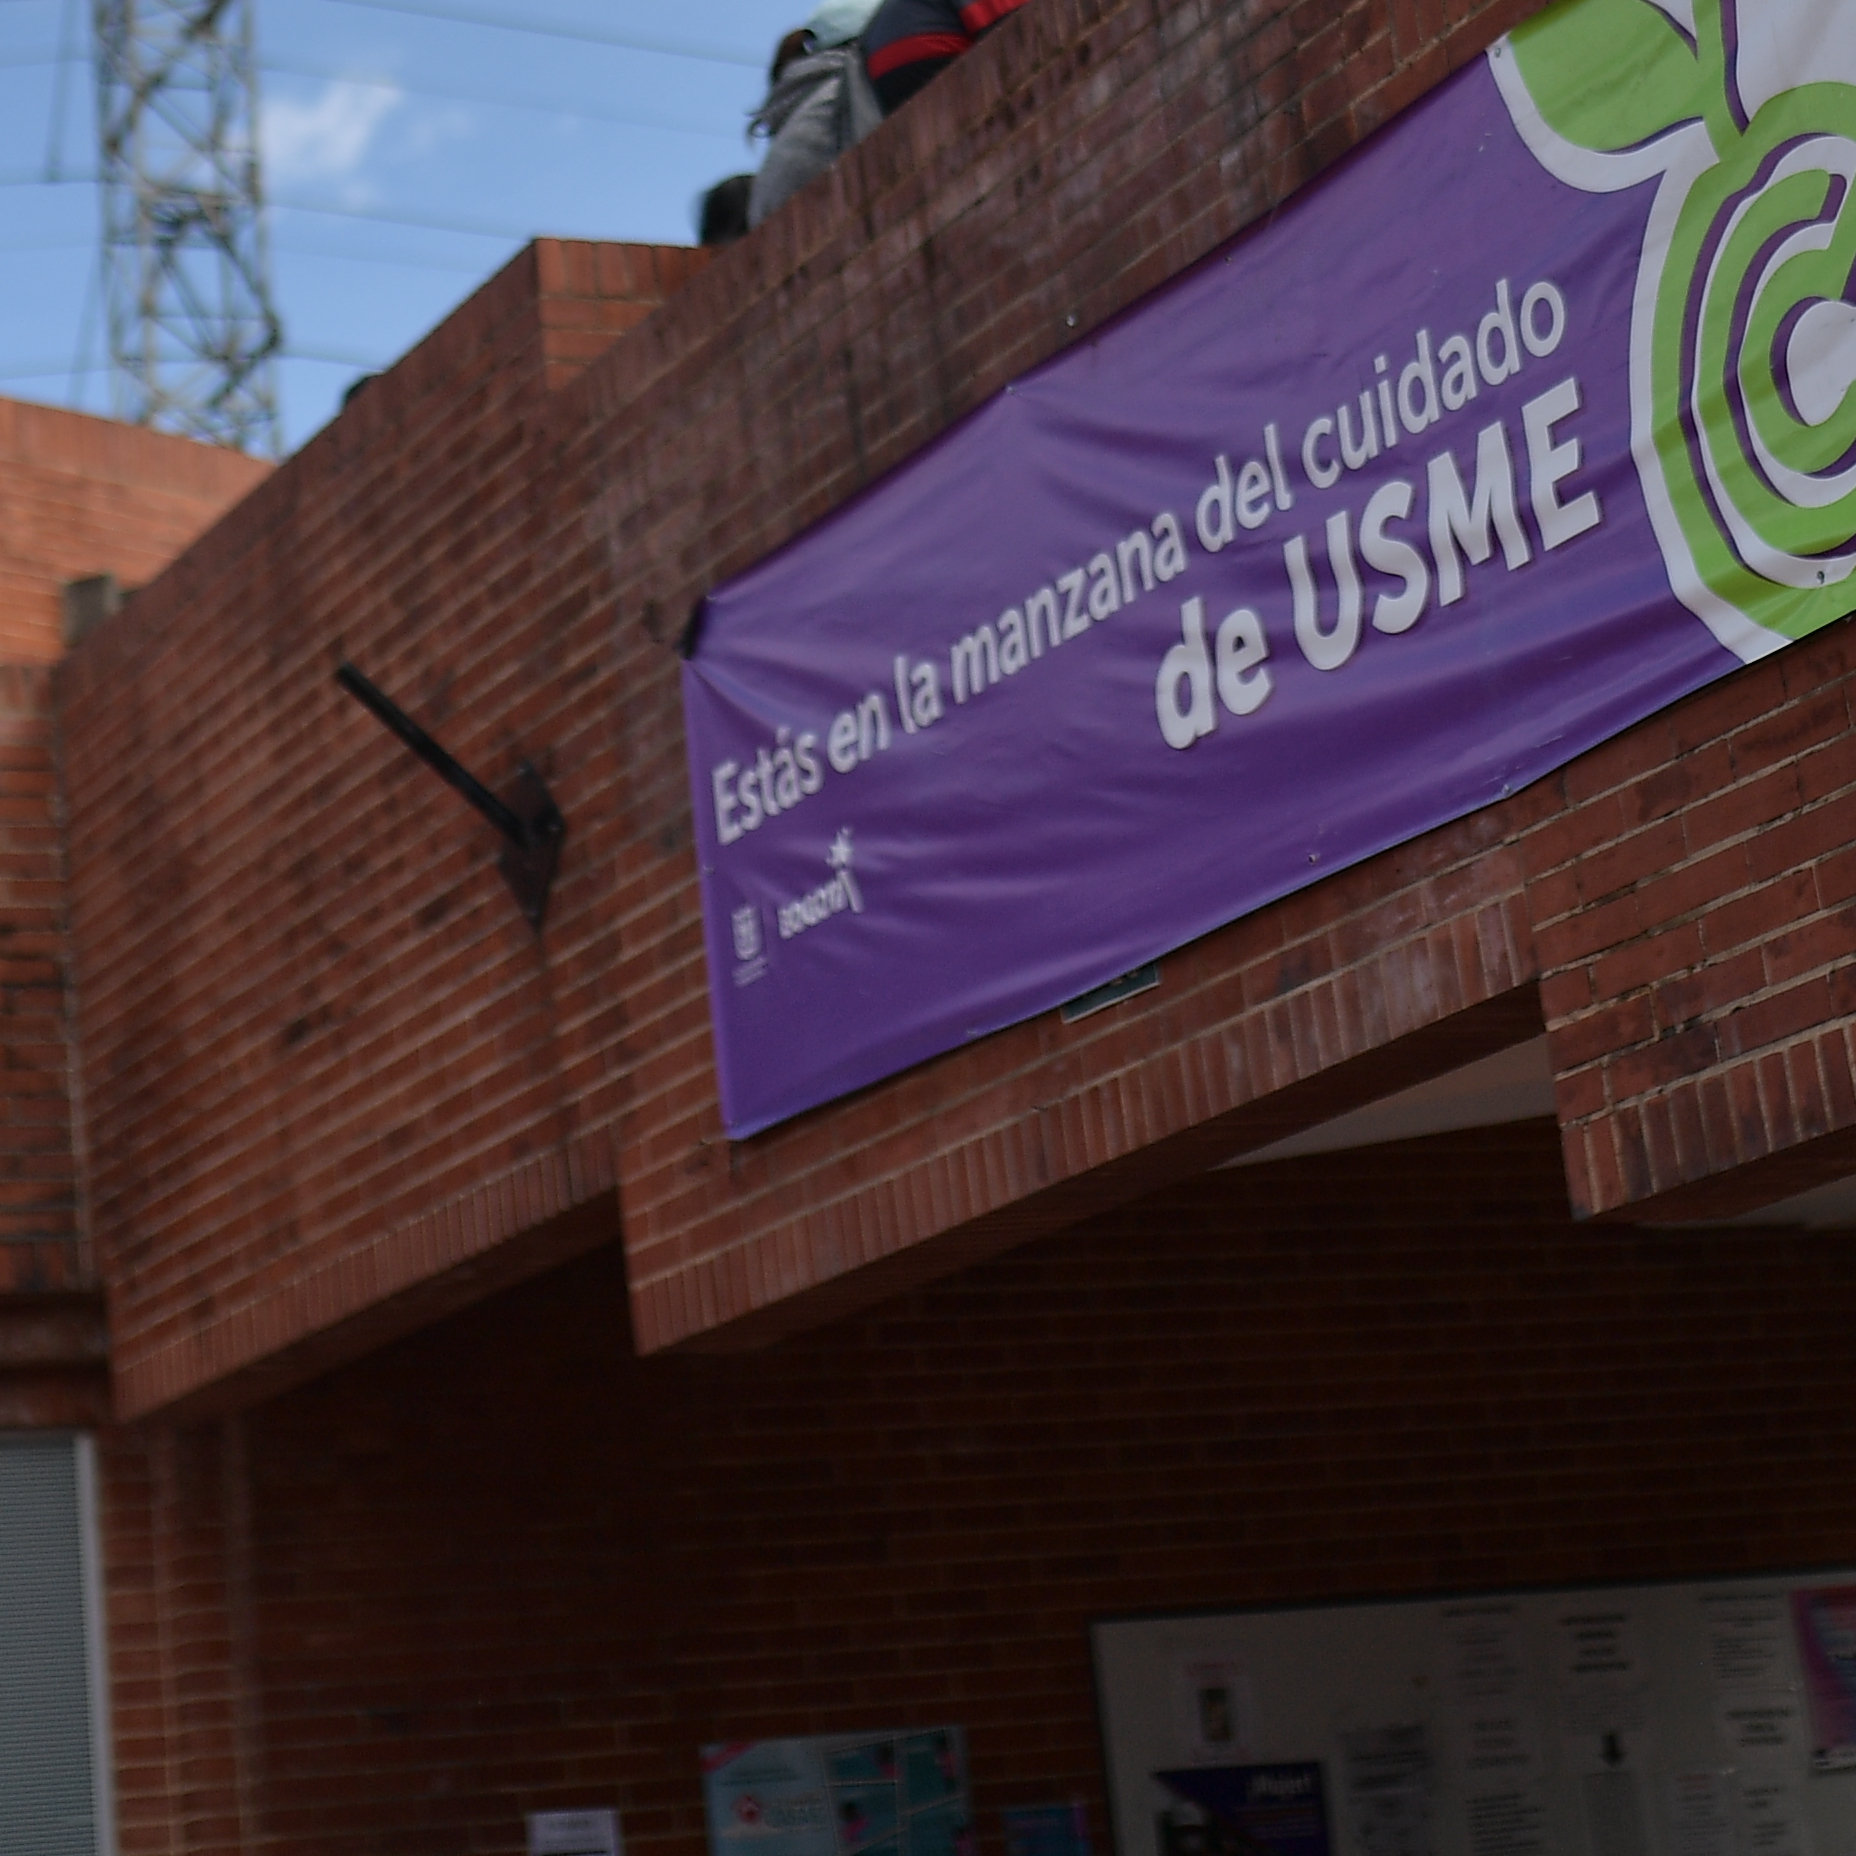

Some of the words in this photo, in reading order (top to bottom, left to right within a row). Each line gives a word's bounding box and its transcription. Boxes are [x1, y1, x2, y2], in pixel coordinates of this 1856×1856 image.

[710, 726, 823, 846] Estás
[826, 693, 889, 774] en
[893, 656, 942, 735] la
[949, 511, 1188, 704] manzana
[1195, 424, 1292, 553] del
[1301, 278, 1565, 489] cuidado
[1155, 596, 1273, 750] de
[1283, 378, 1602, 671] USME
